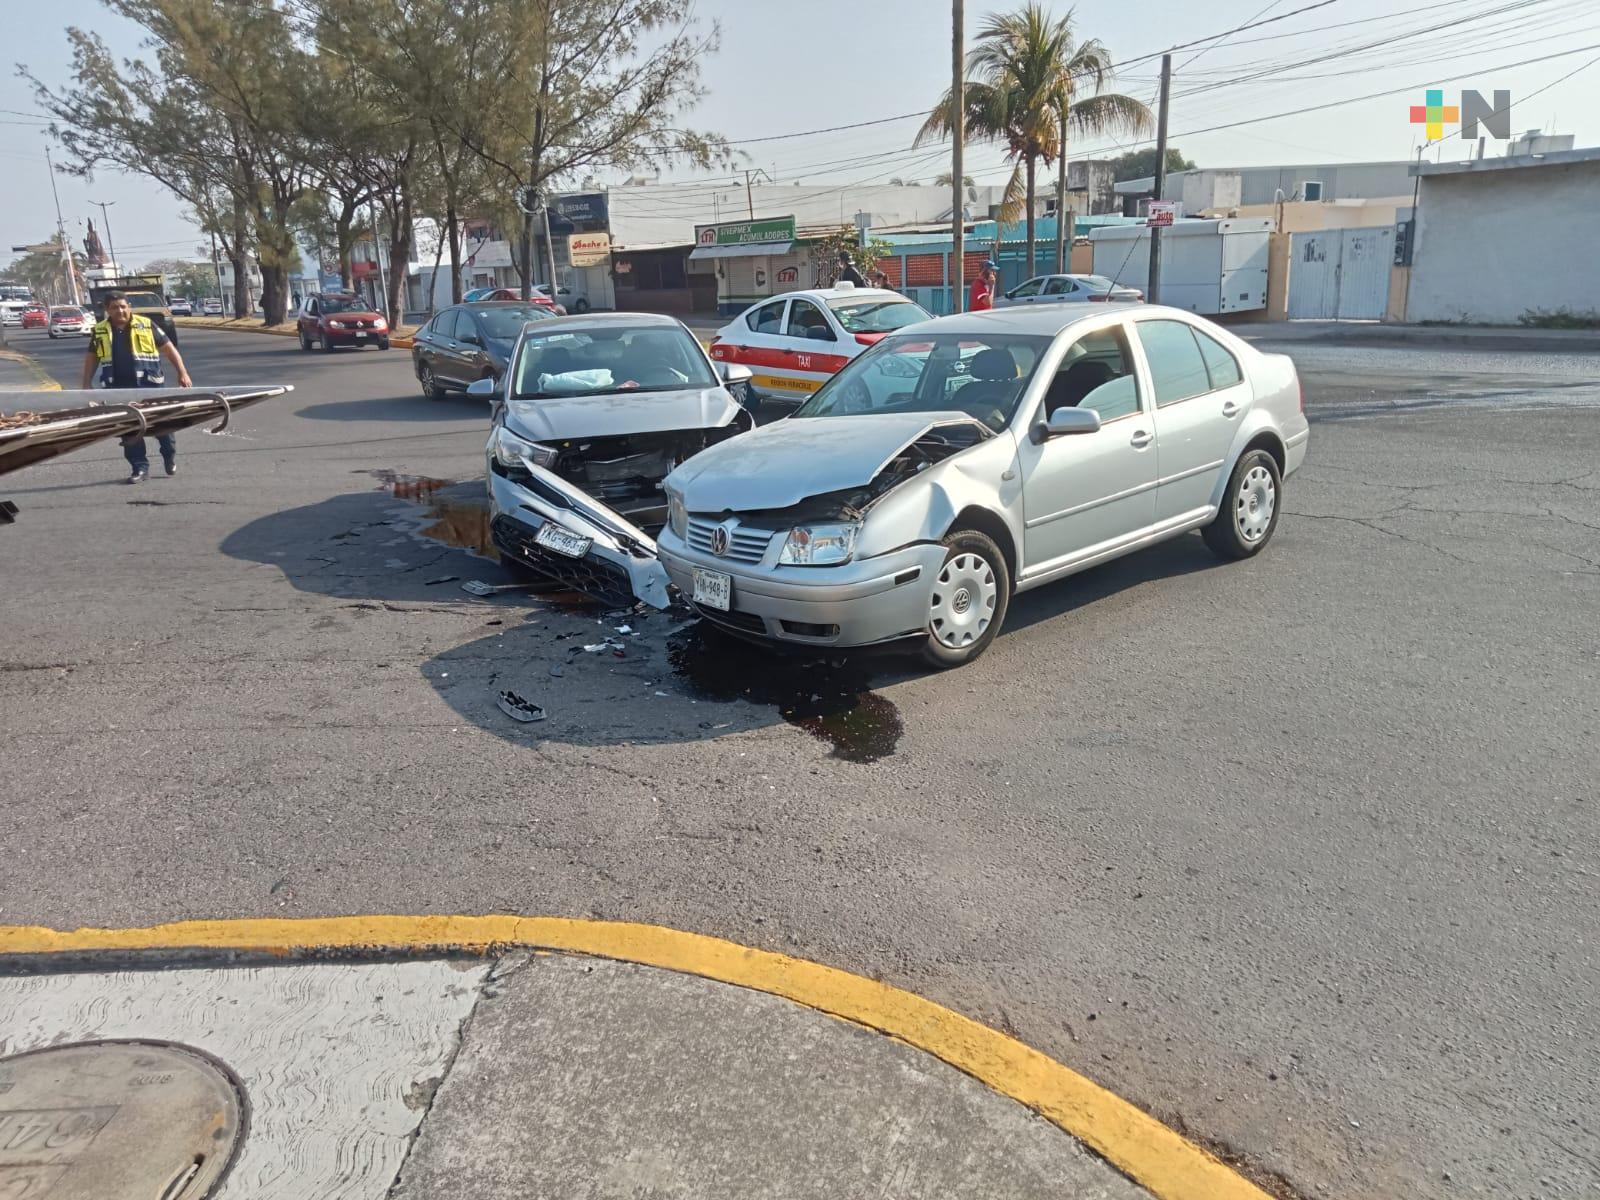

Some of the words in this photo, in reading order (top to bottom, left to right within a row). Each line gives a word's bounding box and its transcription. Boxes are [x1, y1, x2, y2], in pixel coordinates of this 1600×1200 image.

[720, 224, 752, 236] SIVERMEX
[738, 230, 791, 242] ACUMULADORES
[777, 270, 796, 283] LTH
[797, 355, 812, 368] TAXI
